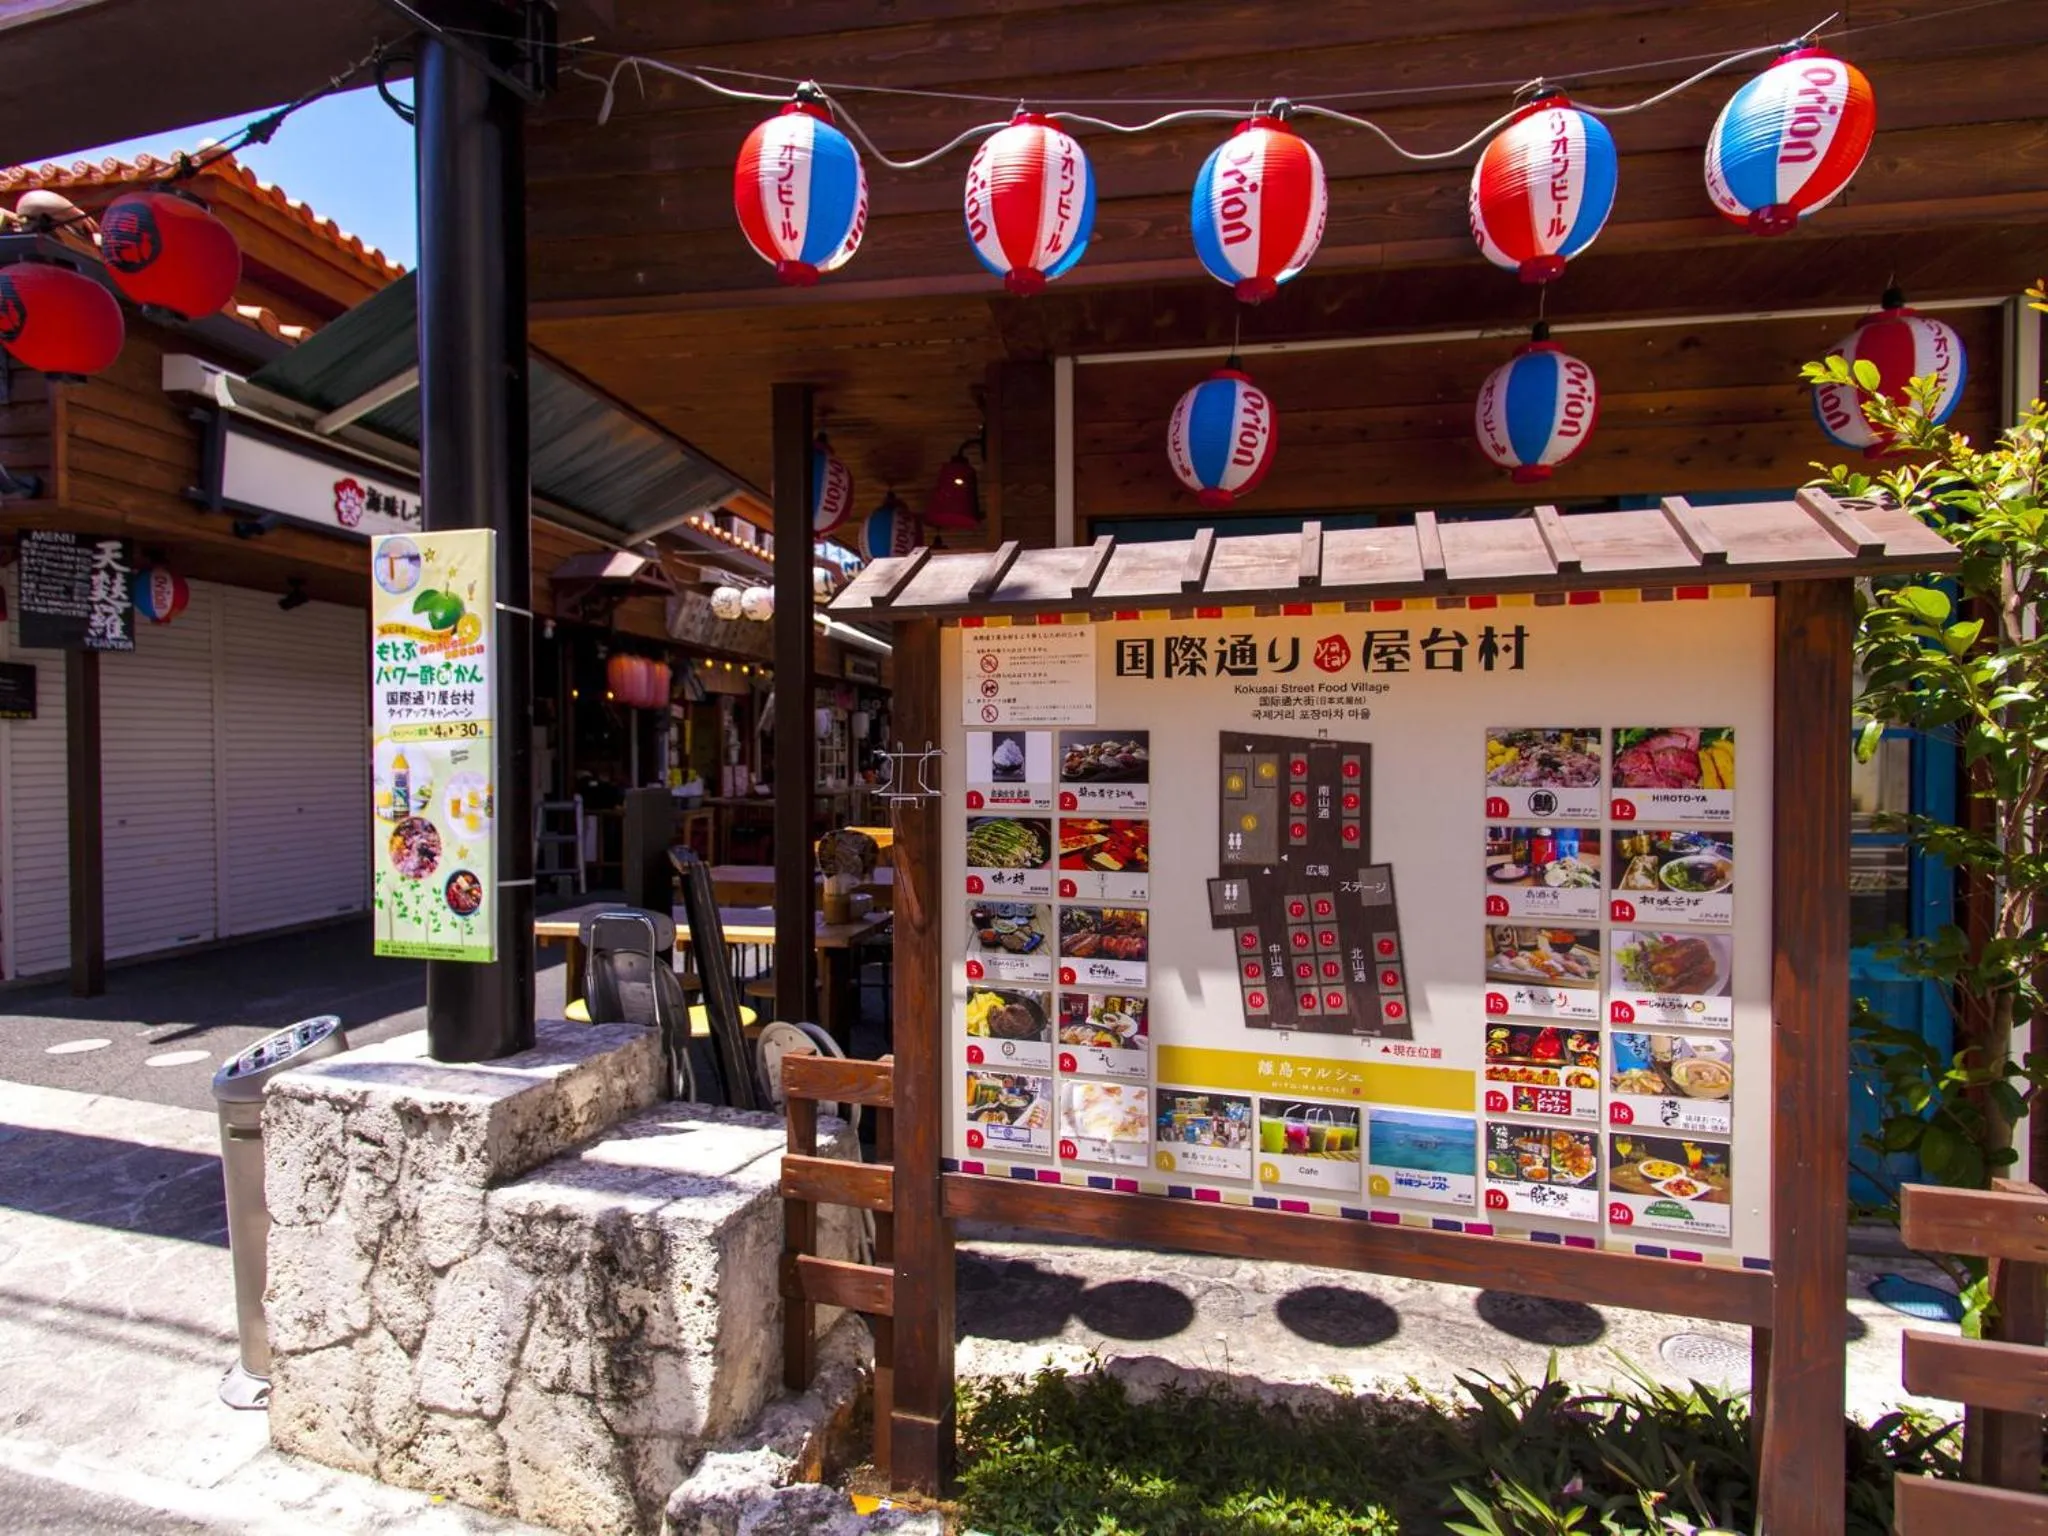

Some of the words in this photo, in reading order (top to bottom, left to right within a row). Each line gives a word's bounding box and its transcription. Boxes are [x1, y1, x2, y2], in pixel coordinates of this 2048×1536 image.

[1780, 67, 1842, 165] Orion
[1220, 147, 1260, 246] Orion
[1558, 361, 1595, 438] Orion
[1233, 389, 1267, 467] Orion
[823, 457, 845, 514] Orion
[32, 531, 76, 544] MENU
[376, 641, 418, 662] もとぶ
[1116, 634, 1300, 678] 国際通り
[1362, 625, 1529, 673] 屋台村
[1234, 683, 1278, 694] Kokusai
[1281, 682, 1314, 693] Street
[1318, 682, 1348, 692] Food
[1351, 681, 1390, 694] Village
[386, 690, 475, 706] 国際通り屋台村
[387, 709, 473, 719] タイアップキャンペーン
[1251, 709, 1295, 720] 국제거리
[1299, 709, 1344, 720] 포장마차
[1348, 708, 1371, 720] 마을
[1294, 764, 1302, 773] 4
[1294, 795, 1302, 804] 5
[1318, 786, 1330, 819] 南山通
[1348, 798, 1354, 806] 2
[1652, 794, 1708, 804] HIROTO-YA
[1490, 803, 1503, 814] 11
[1616, 805, 1630, 816] 12
[1294, 826, 1302, 836] 6
[1348, 828, 1354, 838] 3
[1306, 865, 1330, 876] 広場
[1340, 881, 1386, 893] ステージ
[1292, 904, 1302, 914] 17
[1318, 902, 1328, 912] 13
[1490, 900, 1504, 912] 13
[1614, 905, 1630, 917] 14
[1244, 936, 1255, 946] 20
[1296, 934, 1306, 945] 16
[1322, 934, 1332, 944] 12
[1268, 944, 1284, 978] 中山通
[1351, 948, 1366, 982] 北山通
[1248, 965, 1258, 975] 19
[1300, 965, 1310, 975] 15
[1326, 964, 1336, 974] 11
[1386, 973, 1394, 984] 8
[1251, 995, 1262, 1006] 18
[1304, 996, 1314, 1006] 14
[1330, 996, 1341, 1005] 10
[1488, 998, 1504, 1009] 15
[1390, 1004, 1398, 1015] 9
[1614, 1007, 1630, 1018] 16
[1393, 1044, 1442, 1059] 現在位置
[1258, 1059, 1364, 1083] 離島マルシェ
[1488, 1096, 1503, 1107] 17
[1613, 1108, 1628, 1119] 18
[1062, 1145, 1074, 1154] 10
[1264, 1166, 1272, 1178] B
[1299, 1166, 1319, 1177] Cafe
[1372, 1181, 1382, 1192] C
[1488, 1196, 1504, 1207] 19
[1612, 1208, 1629, 1220] 20
